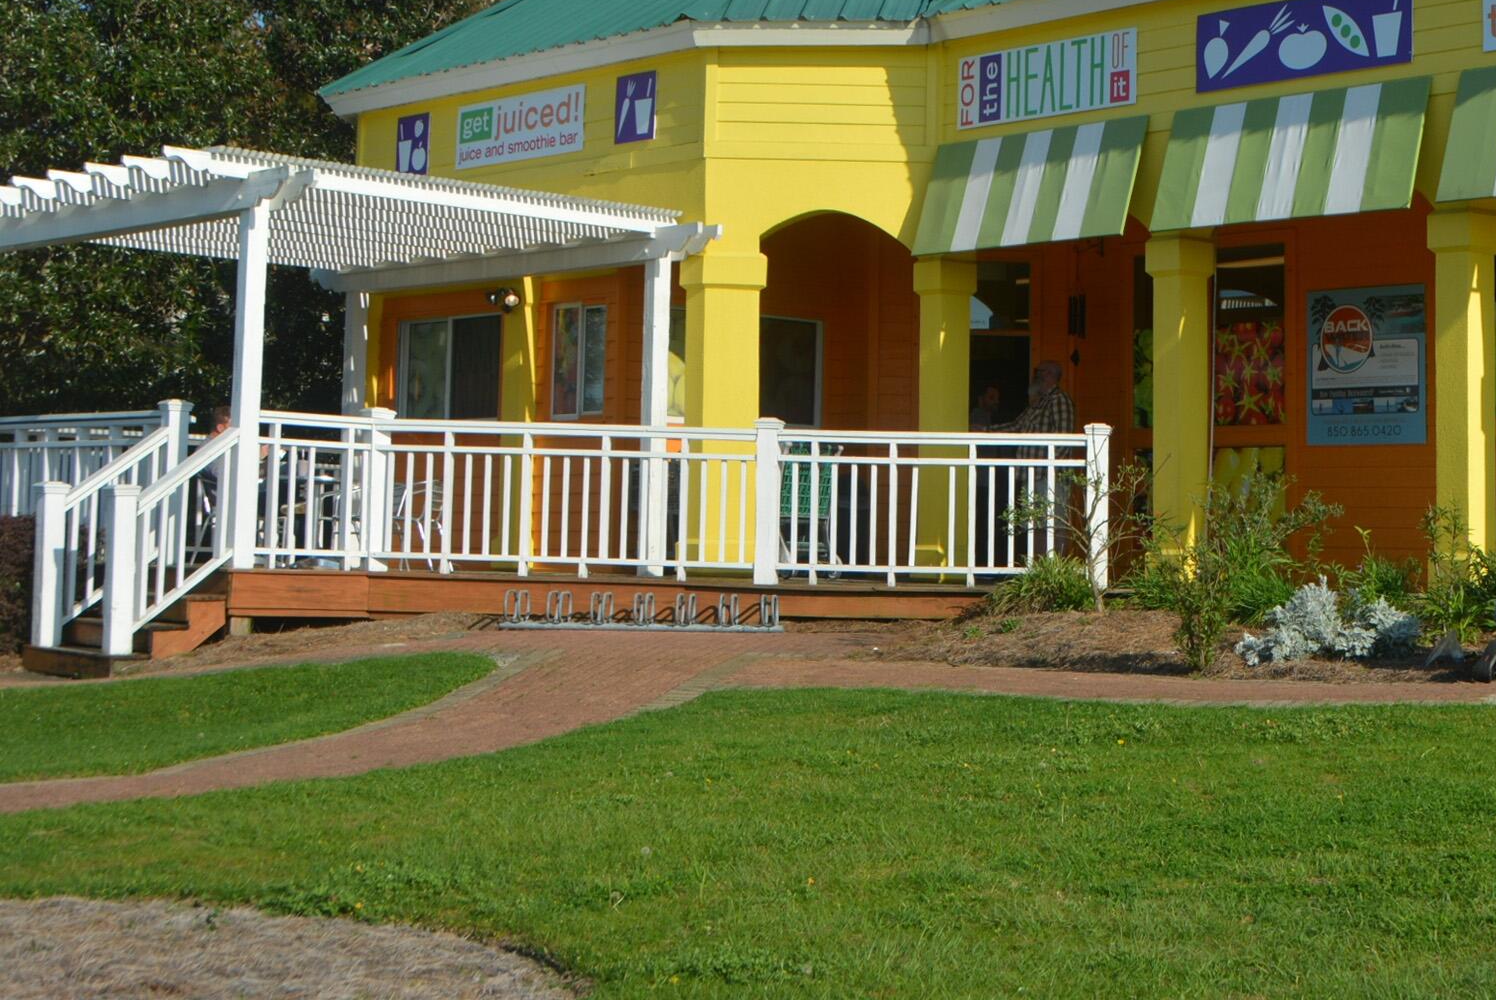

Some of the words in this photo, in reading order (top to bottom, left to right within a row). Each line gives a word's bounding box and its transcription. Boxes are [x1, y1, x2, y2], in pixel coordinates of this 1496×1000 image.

[1112, 31, 1130, 69] OF
[960, 59, 975, 127] FOR
[982, 61, 999, 116] the
[1006, 35, 1105, 119] HEALTH
[1112, 76, 1127, 98] it
[463, 111, 489, 139] get
[495, 92, 580, 141] juiced!
[458, 147, 482, 165] juice
[485, 141, 505, 158] and
[508, 132, 556, 154] smoothie
[560, 131, 578, 146] bar
[1324, 319, 1369, 334] BACK
